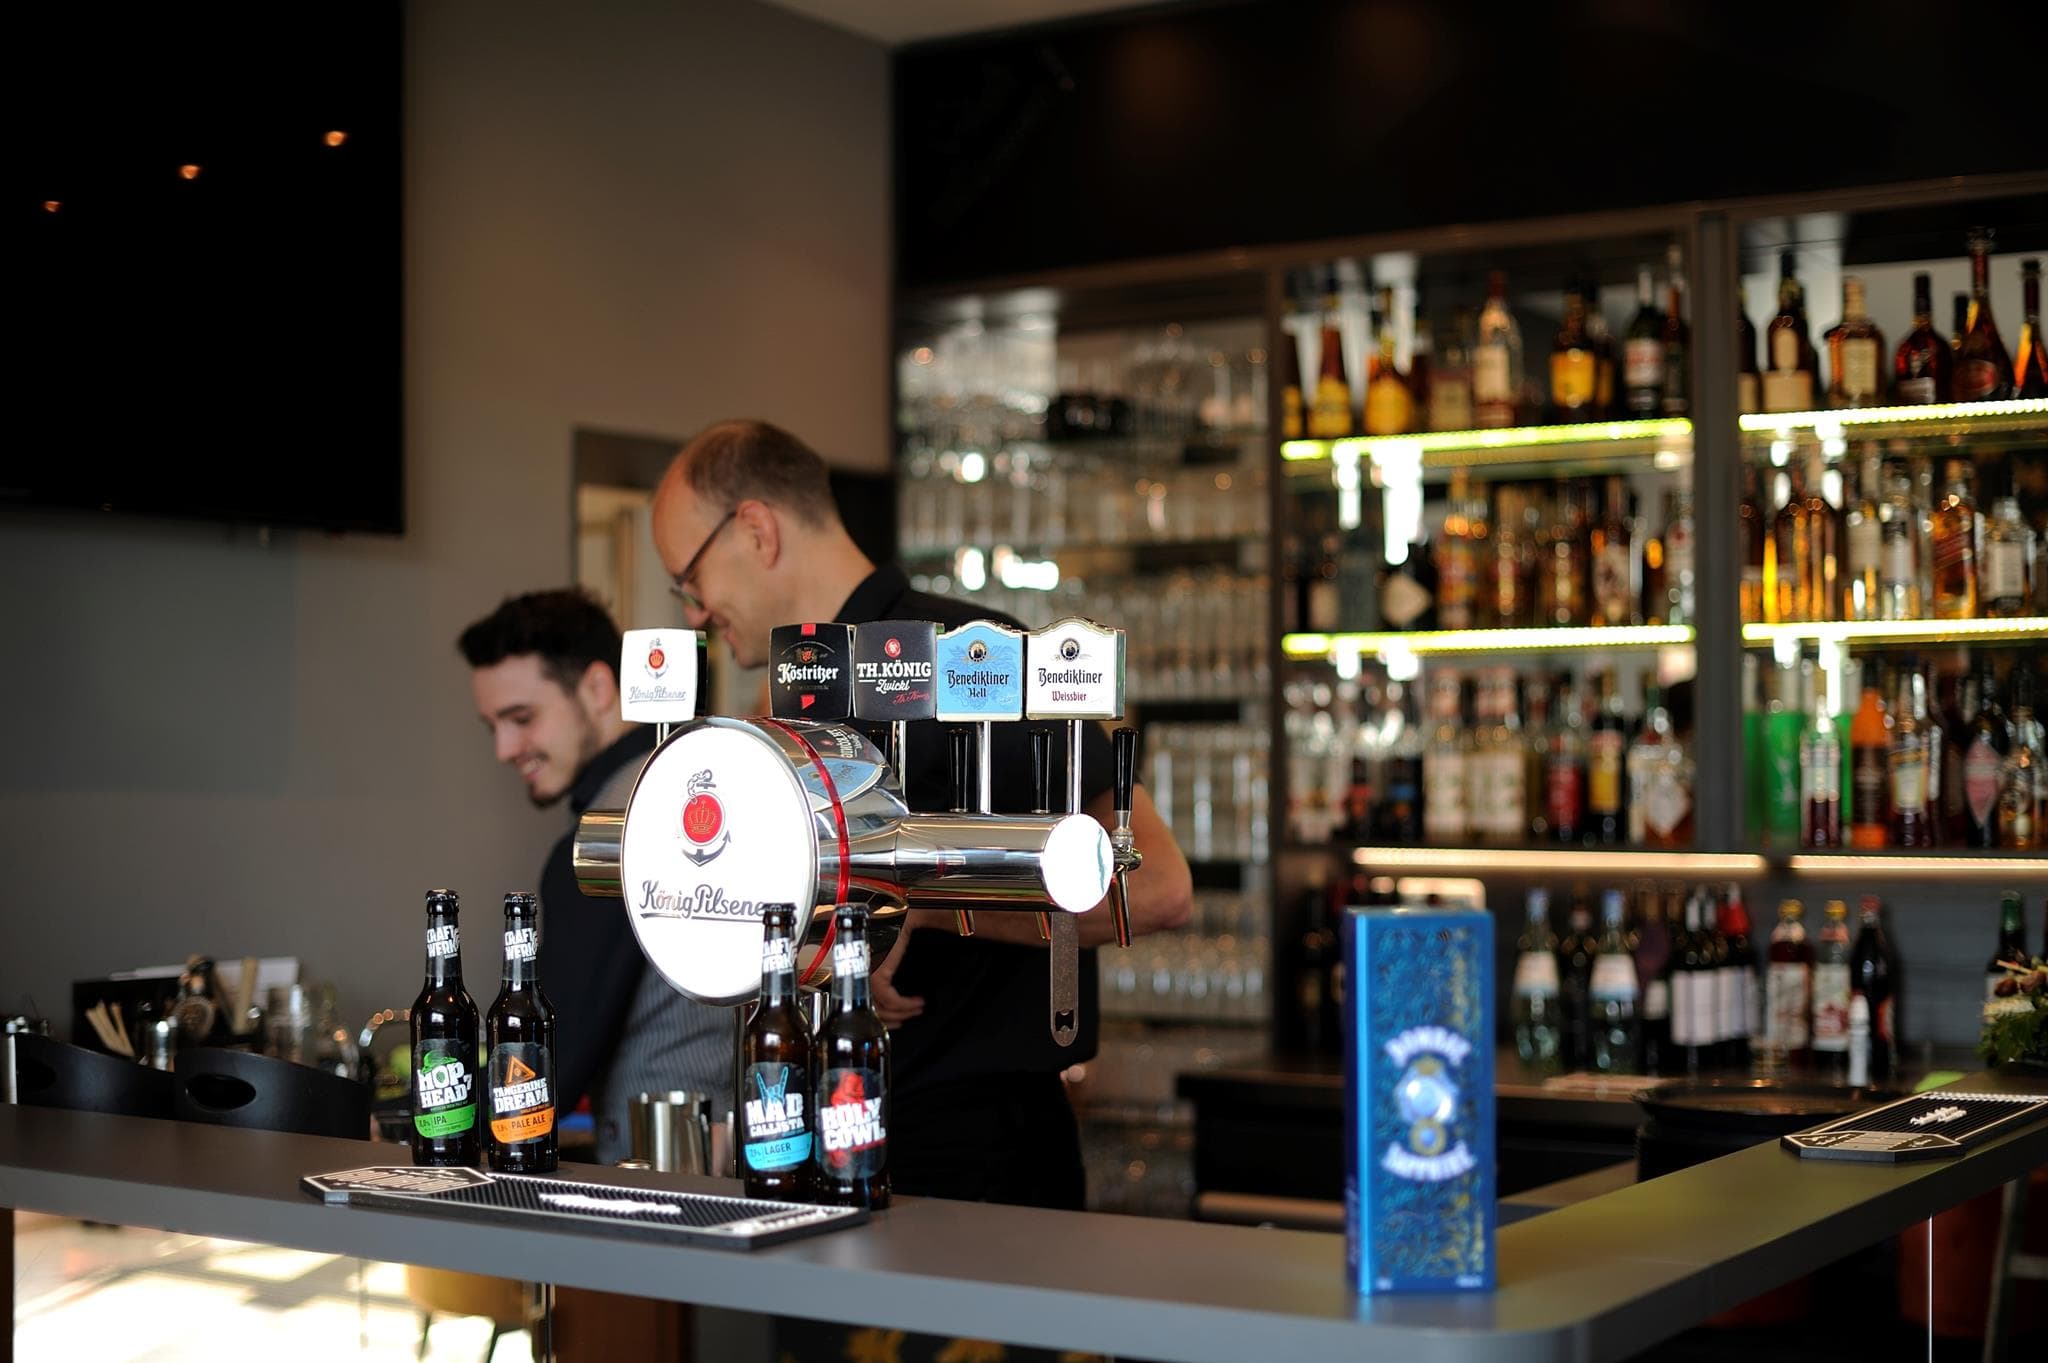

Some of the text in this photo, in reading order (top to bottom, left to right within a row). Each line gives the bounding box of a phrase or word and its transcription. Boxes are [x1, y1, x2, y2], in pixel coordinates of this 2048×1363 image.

[777, 663, 840, 684] Köstritzer
[856, 660, 932, 678] TH.KÖNIG
[1038, 667, 1103, 687] Benediktiner
[875, 679, 911, 694] Zwickl
[946, 670, 1010, 688] Benediktiner
[967, 688, 987, 698] Hell
[1051, 691, 1087, 702] Weissbier
[420, 1084, 468, 1108] HEAD
[493, 1077, 547, 1097] TANGERINE
[494, 1088, 549, 1113] DREAM
[745, 1092, 804, 1126] MAD
[433, 1115, 447, 1126] IPA
[511, 1118, 531, 1129] PALE
[533, 1114, 546, 1125] ALE
[764, 1142, 792, 1155] LAGER
